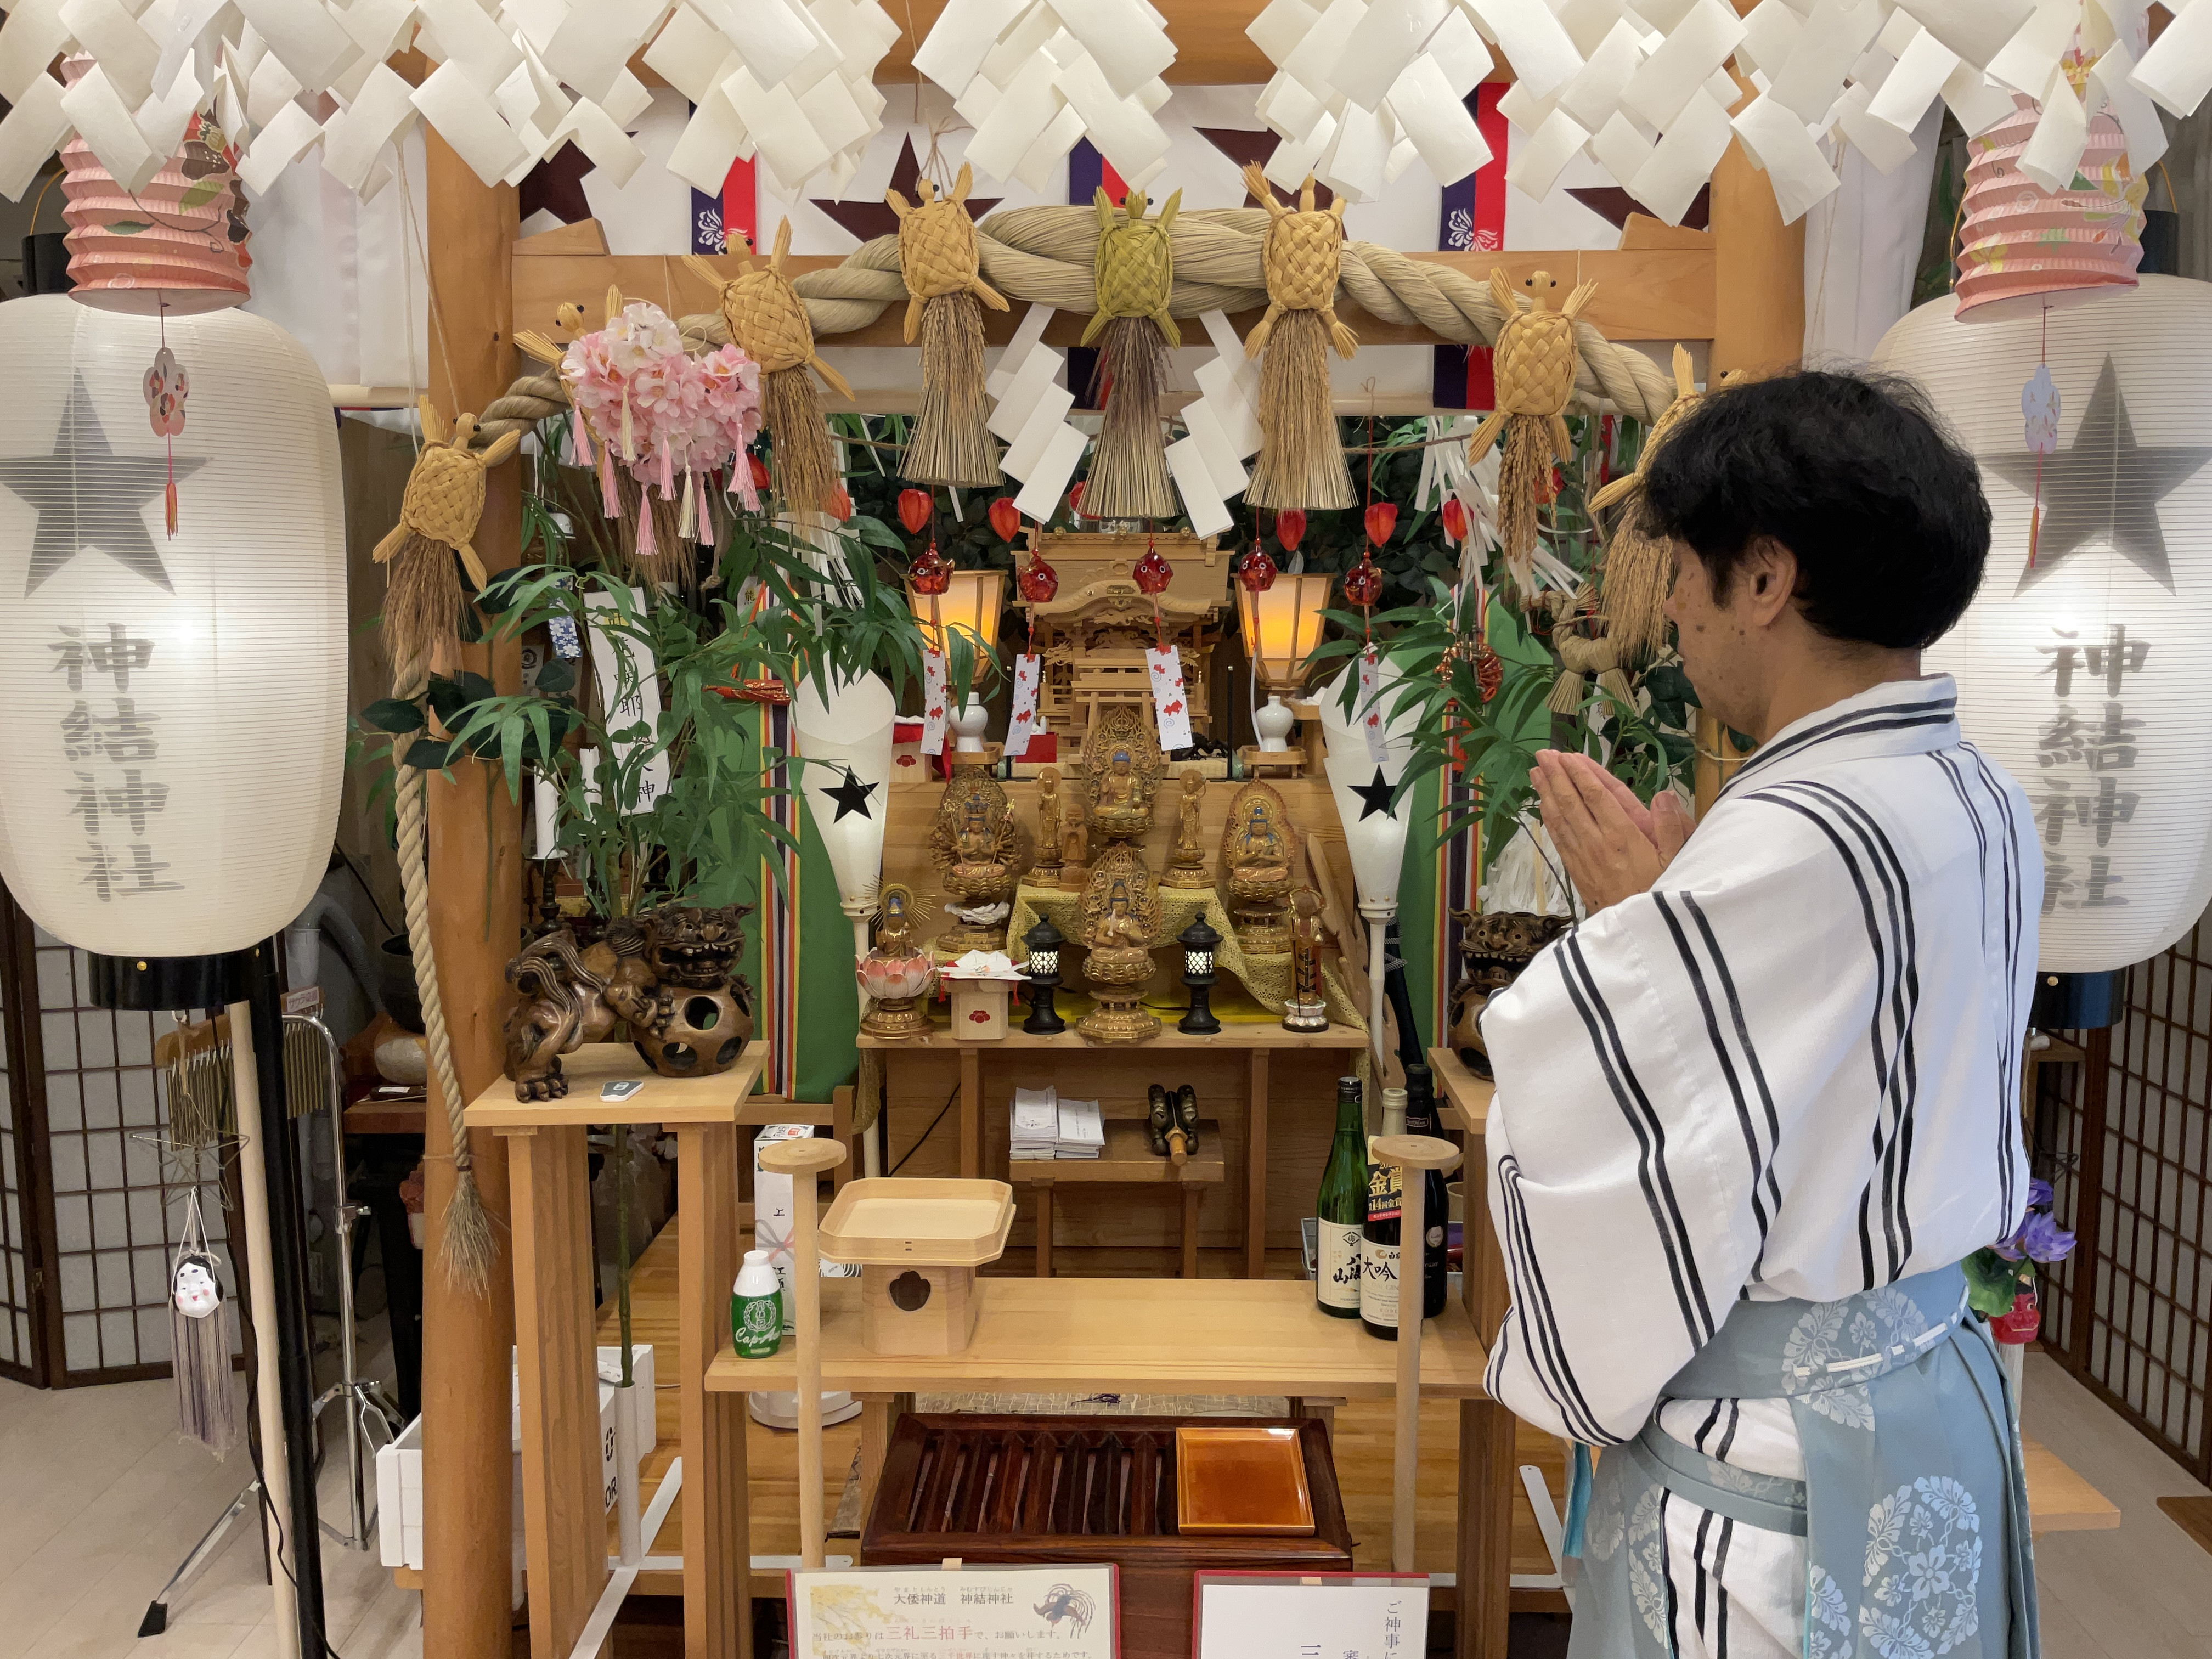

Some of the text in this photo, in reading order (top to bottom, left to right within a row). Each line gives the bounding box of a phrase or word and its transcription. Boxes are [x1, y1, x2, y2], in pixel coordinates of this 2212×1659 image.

[47, 623, 185, 902] 神結神社
[2029, 624, 2151, 915] 神結神社
[1368, 1166, 1402, 1197] 金賞
[894, 1593, 1014, 1605] 大倭神道 神結神社
